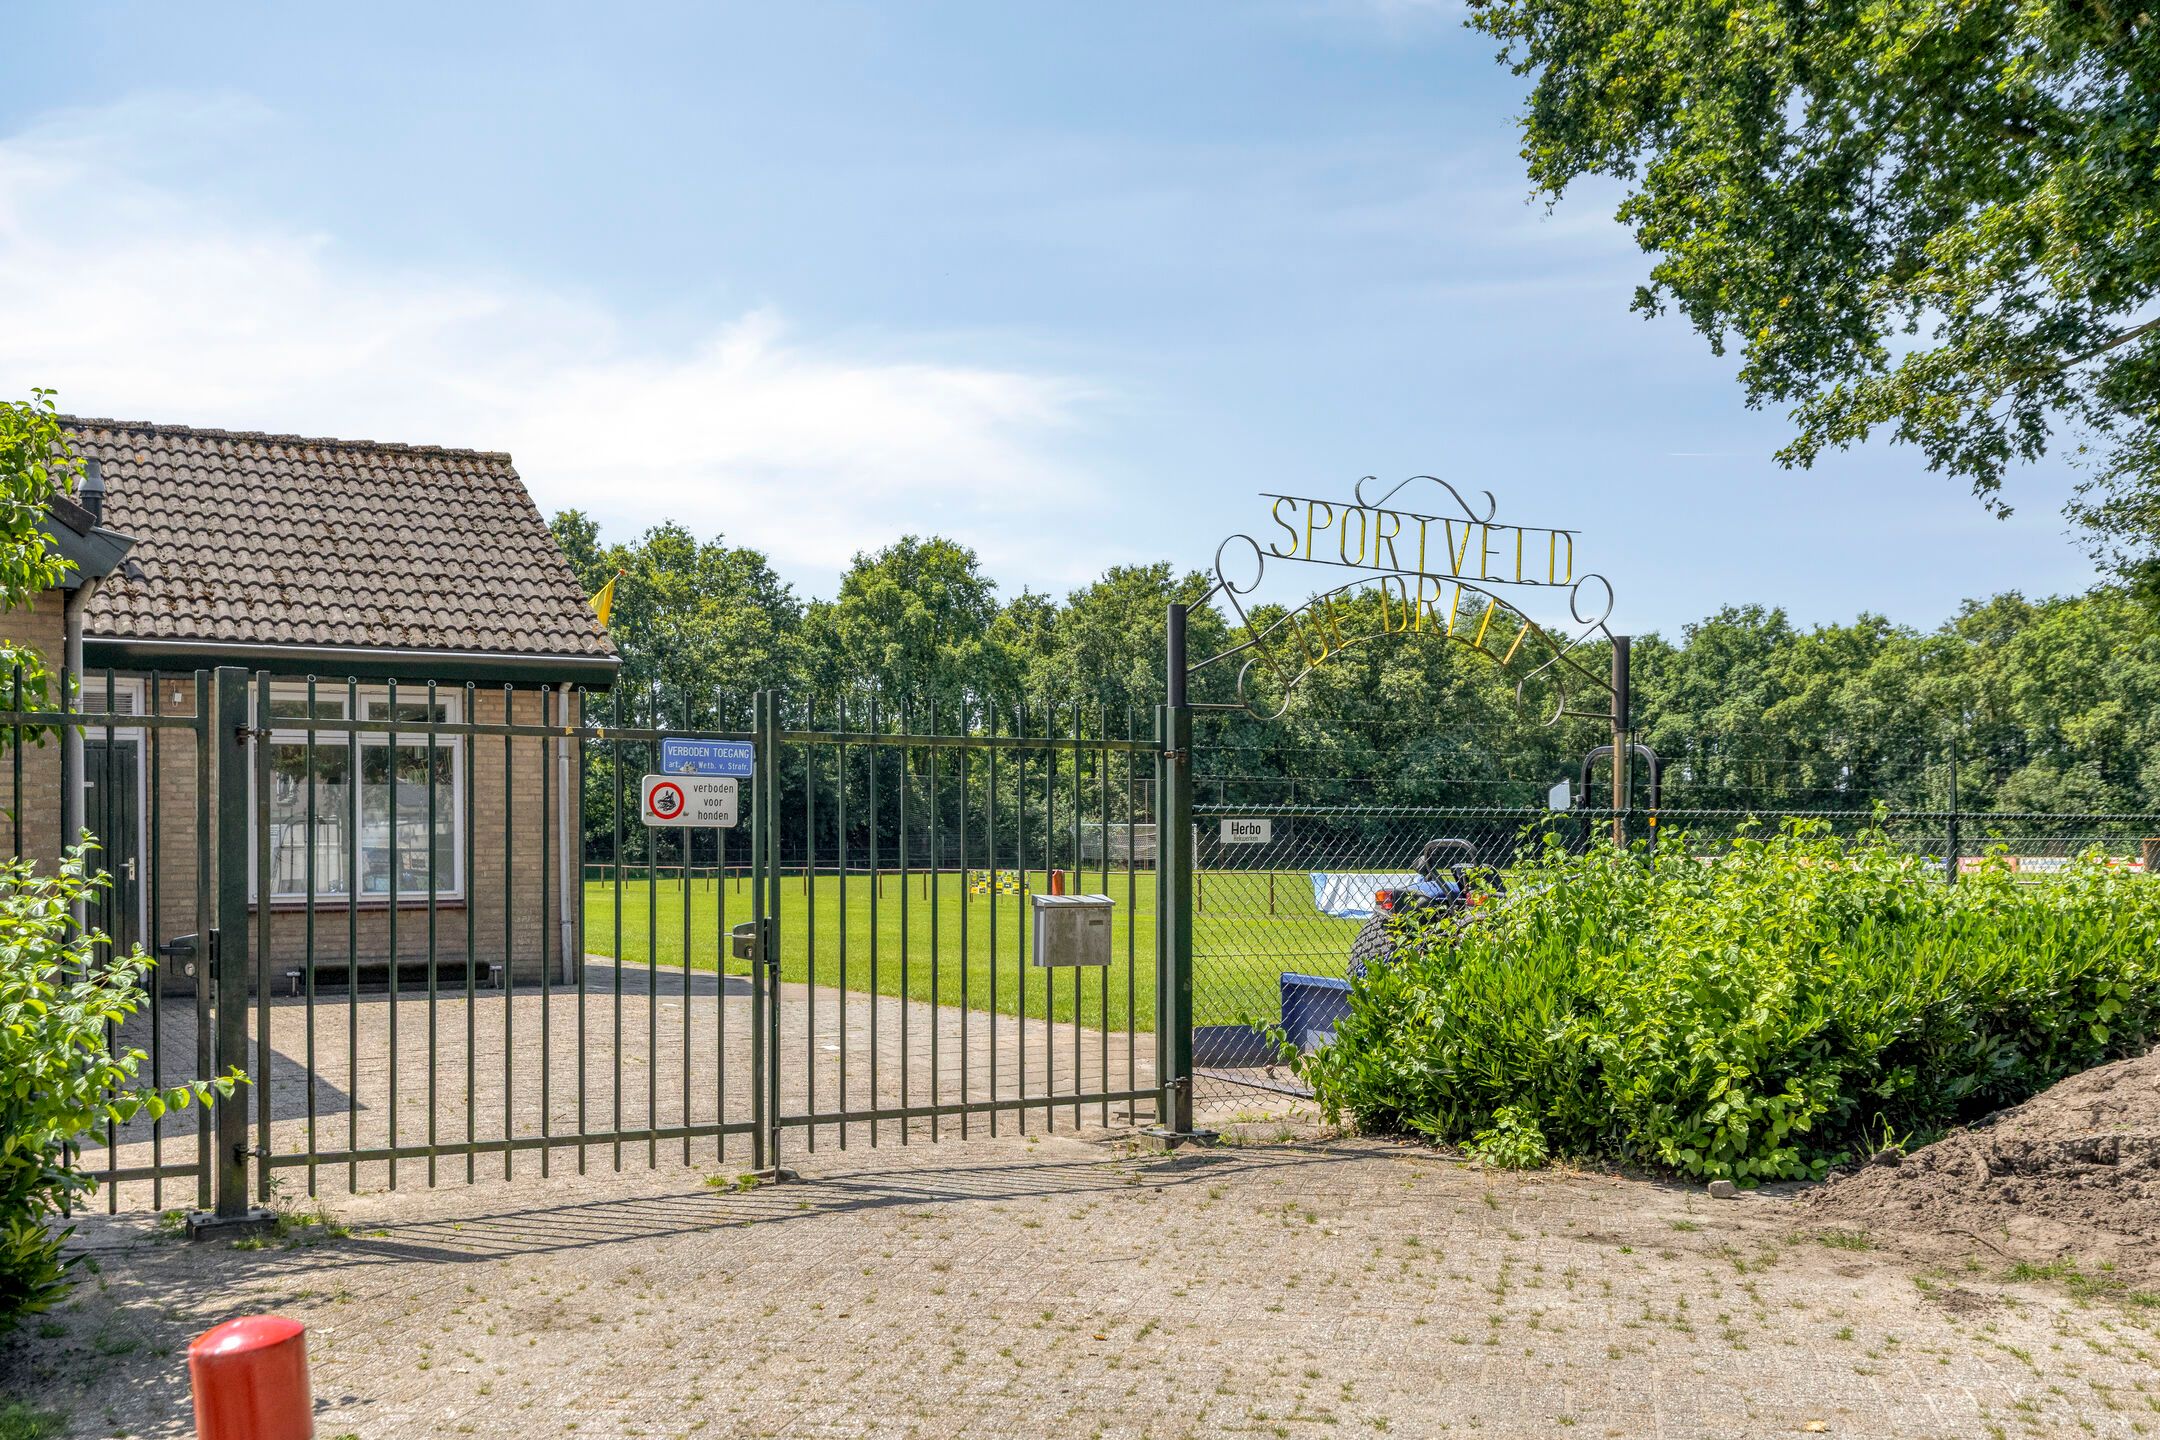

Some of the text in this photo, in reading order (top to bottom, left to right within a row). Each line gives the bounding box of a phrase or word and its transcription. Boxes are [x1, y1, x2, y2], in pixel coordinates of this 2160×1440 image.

[1269, 495, 1574, 586] SPORTVELD
[1288, 584, 1360, 668] DE
[667, 745, 750, 759] VERBODEN TOEGANG
[693, 783, 734, 793] verboden
[703, 798, 724, 807] voor
[697, 810, 729, 820] honden
[1231, 821, 1261, 835] Herbo
